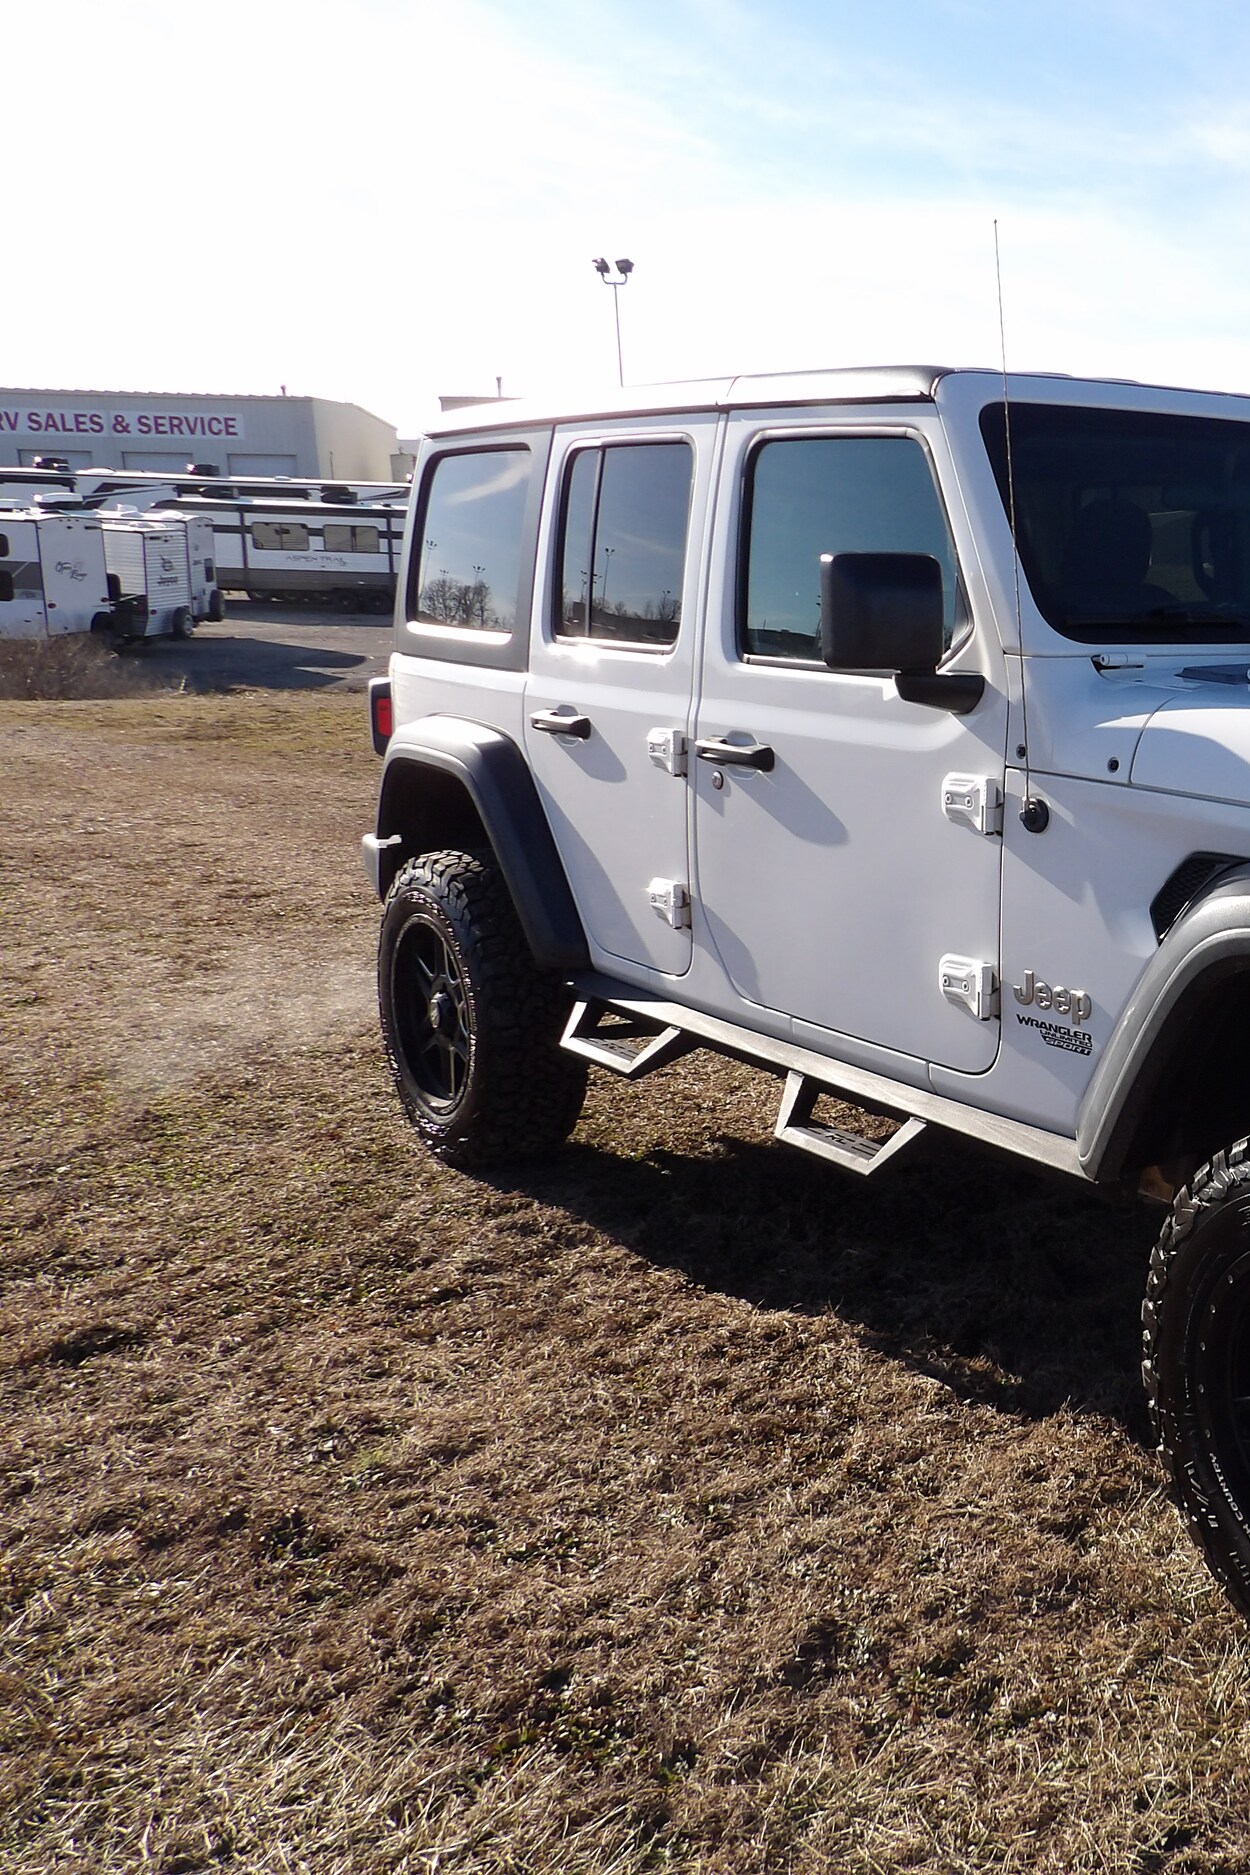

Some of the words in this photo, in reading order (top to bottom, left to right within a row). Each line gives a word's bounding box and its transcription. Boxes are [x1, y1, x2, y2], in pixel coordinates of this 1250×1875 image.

[27, 412, 104, 433] SALES
[112, 414, 132, 434] &
[137, 415, 239, 436] SERVICE
[1012, 969, 1092, 1026] Jeep
[1016, 1013, 1092, 1043] WRANGLER
[1040, 1029, 1093, 1048] UNLIMITED
[1044, 1036, 1092, 1056] SPORT
[1209, 1452, 1244, 1522] COUNTRY
